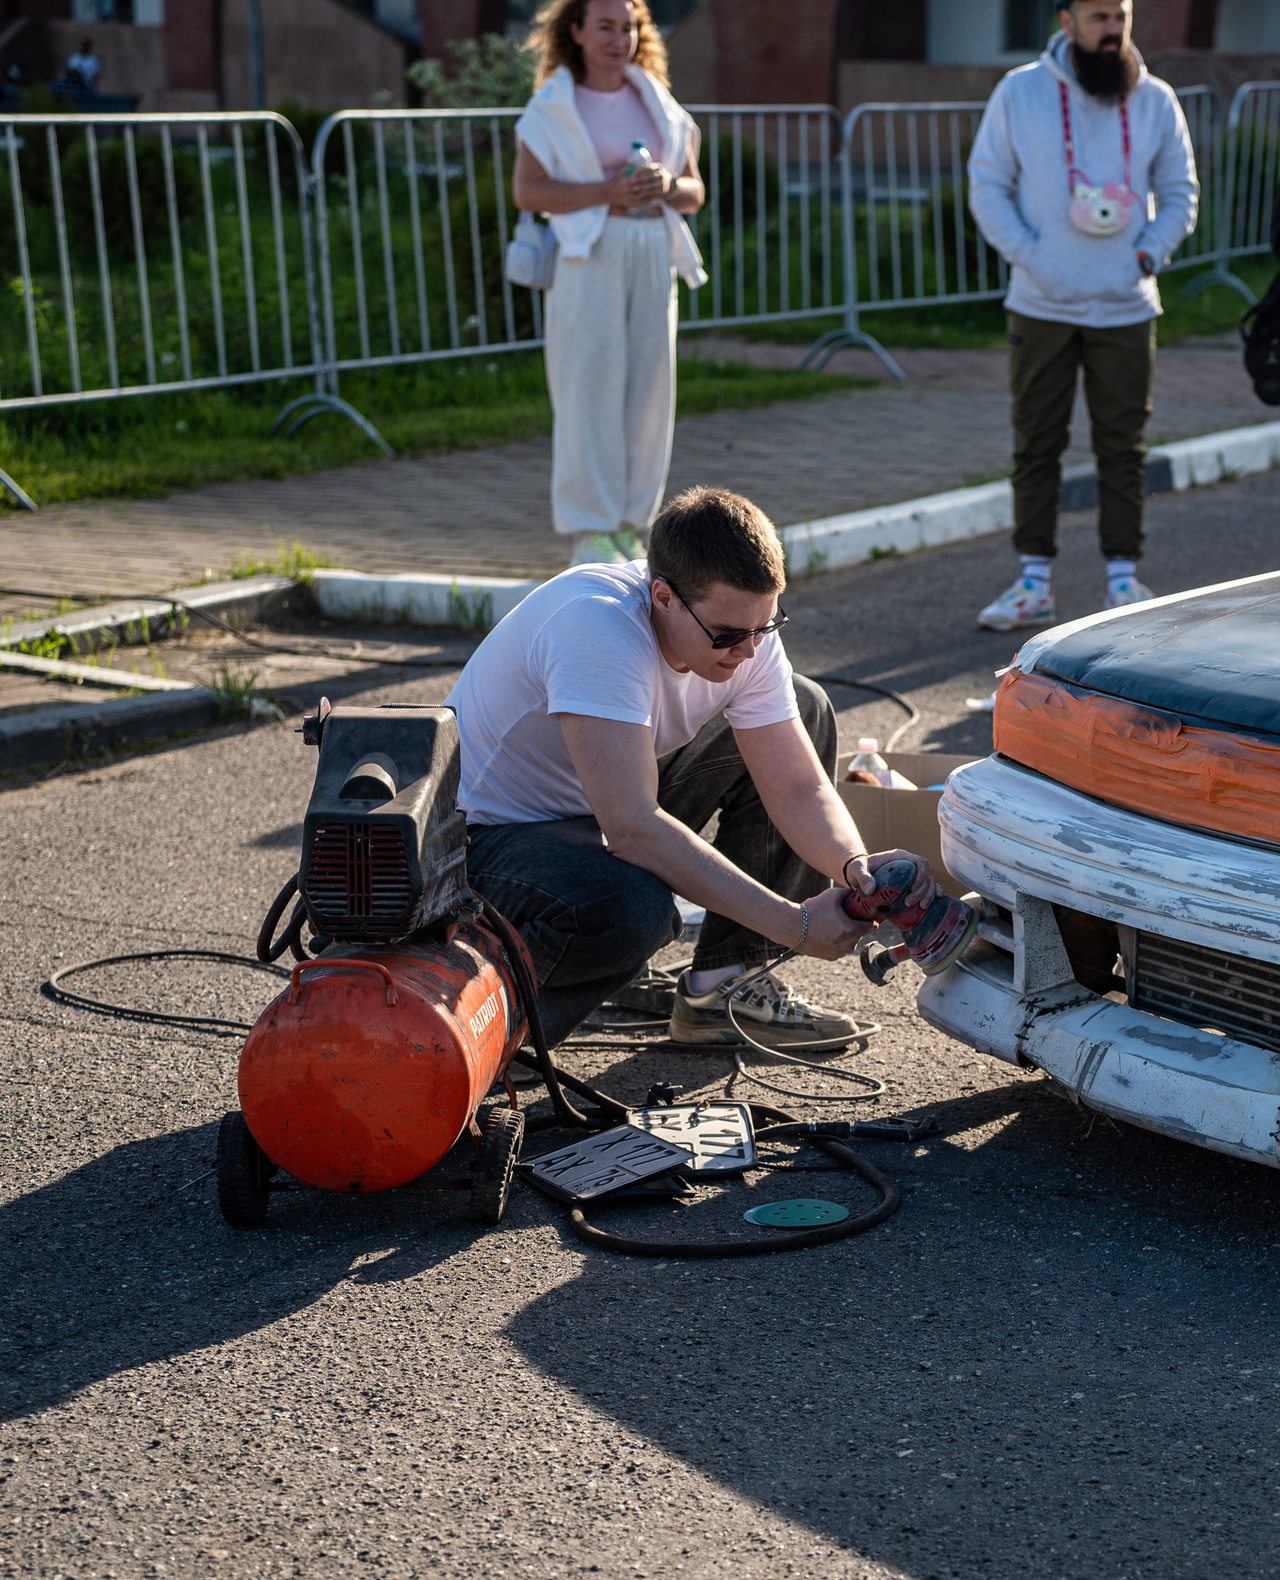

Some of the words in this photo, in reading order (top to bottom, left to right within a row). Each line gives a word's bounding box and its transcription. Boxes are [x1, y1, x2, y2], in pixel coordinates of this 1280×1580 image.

[468, 991, 499, 1040] PATRIOT
[615, 1142, 679, 1168] 177
[584, 1168, 628, 1188] 76
